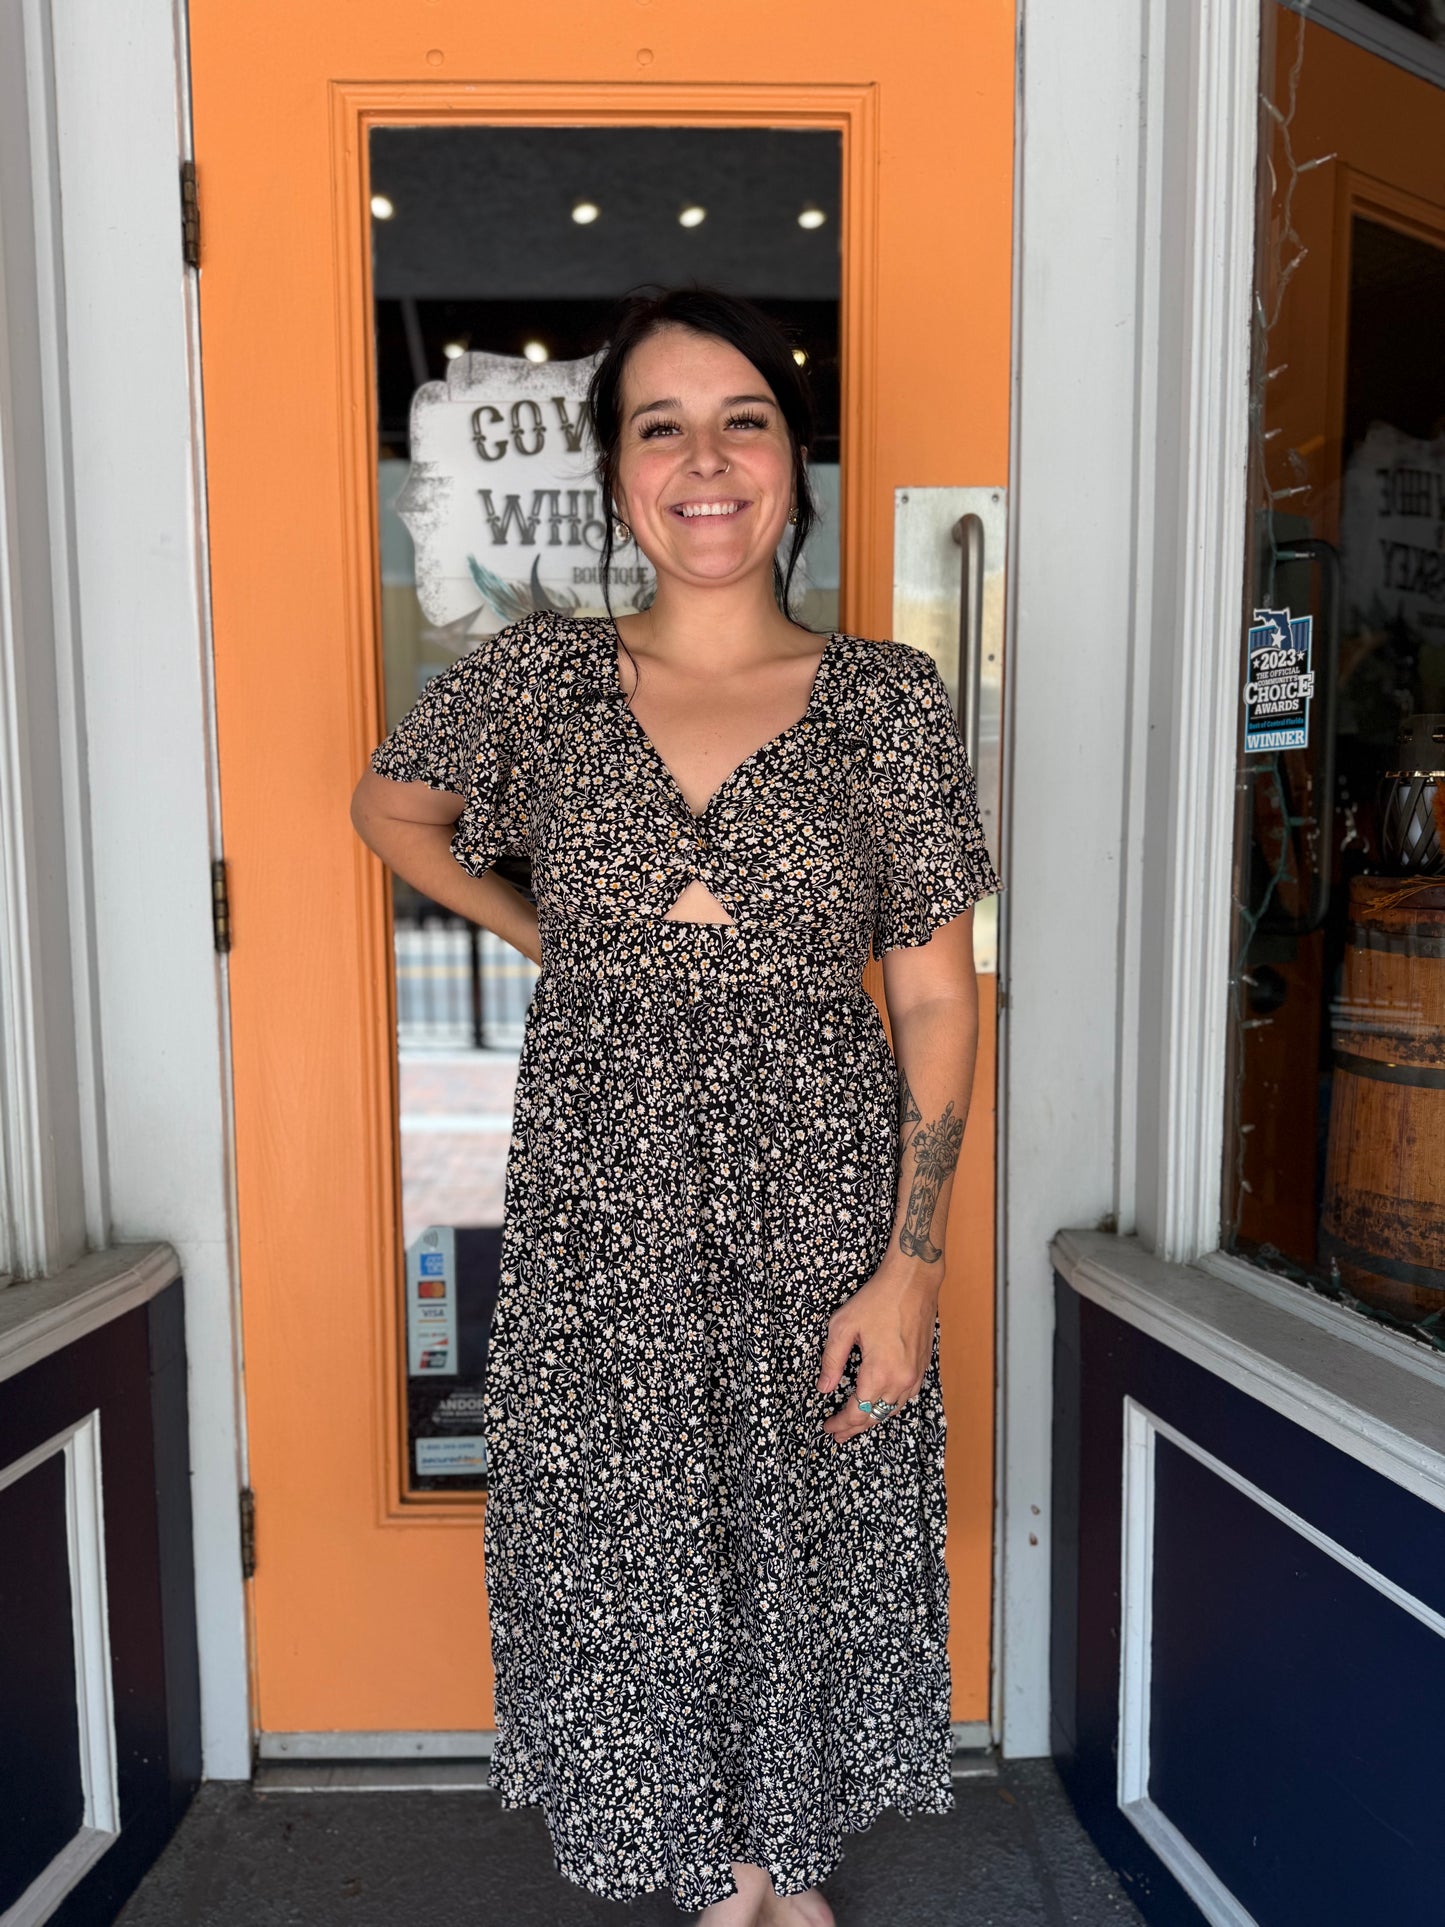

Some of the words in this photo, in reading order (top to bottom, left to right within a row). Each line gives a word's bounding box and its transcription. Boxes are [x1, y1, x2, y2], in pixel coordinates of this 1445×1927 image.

[573, 566, 649, 586] BOUTIQUE
[1260, 648, 1296, 671] 2023
[1256, 671, 1269, 680] THE
[1269, 666, 1300, 677] OFFICIAL
[1244, 672, 1313, 705] CHOICE
[1254, 699, 1300, 715] AWARDS
[1247, 729, 1305, 749] WINNER
[422, 1308, 445, 1317] VISA
